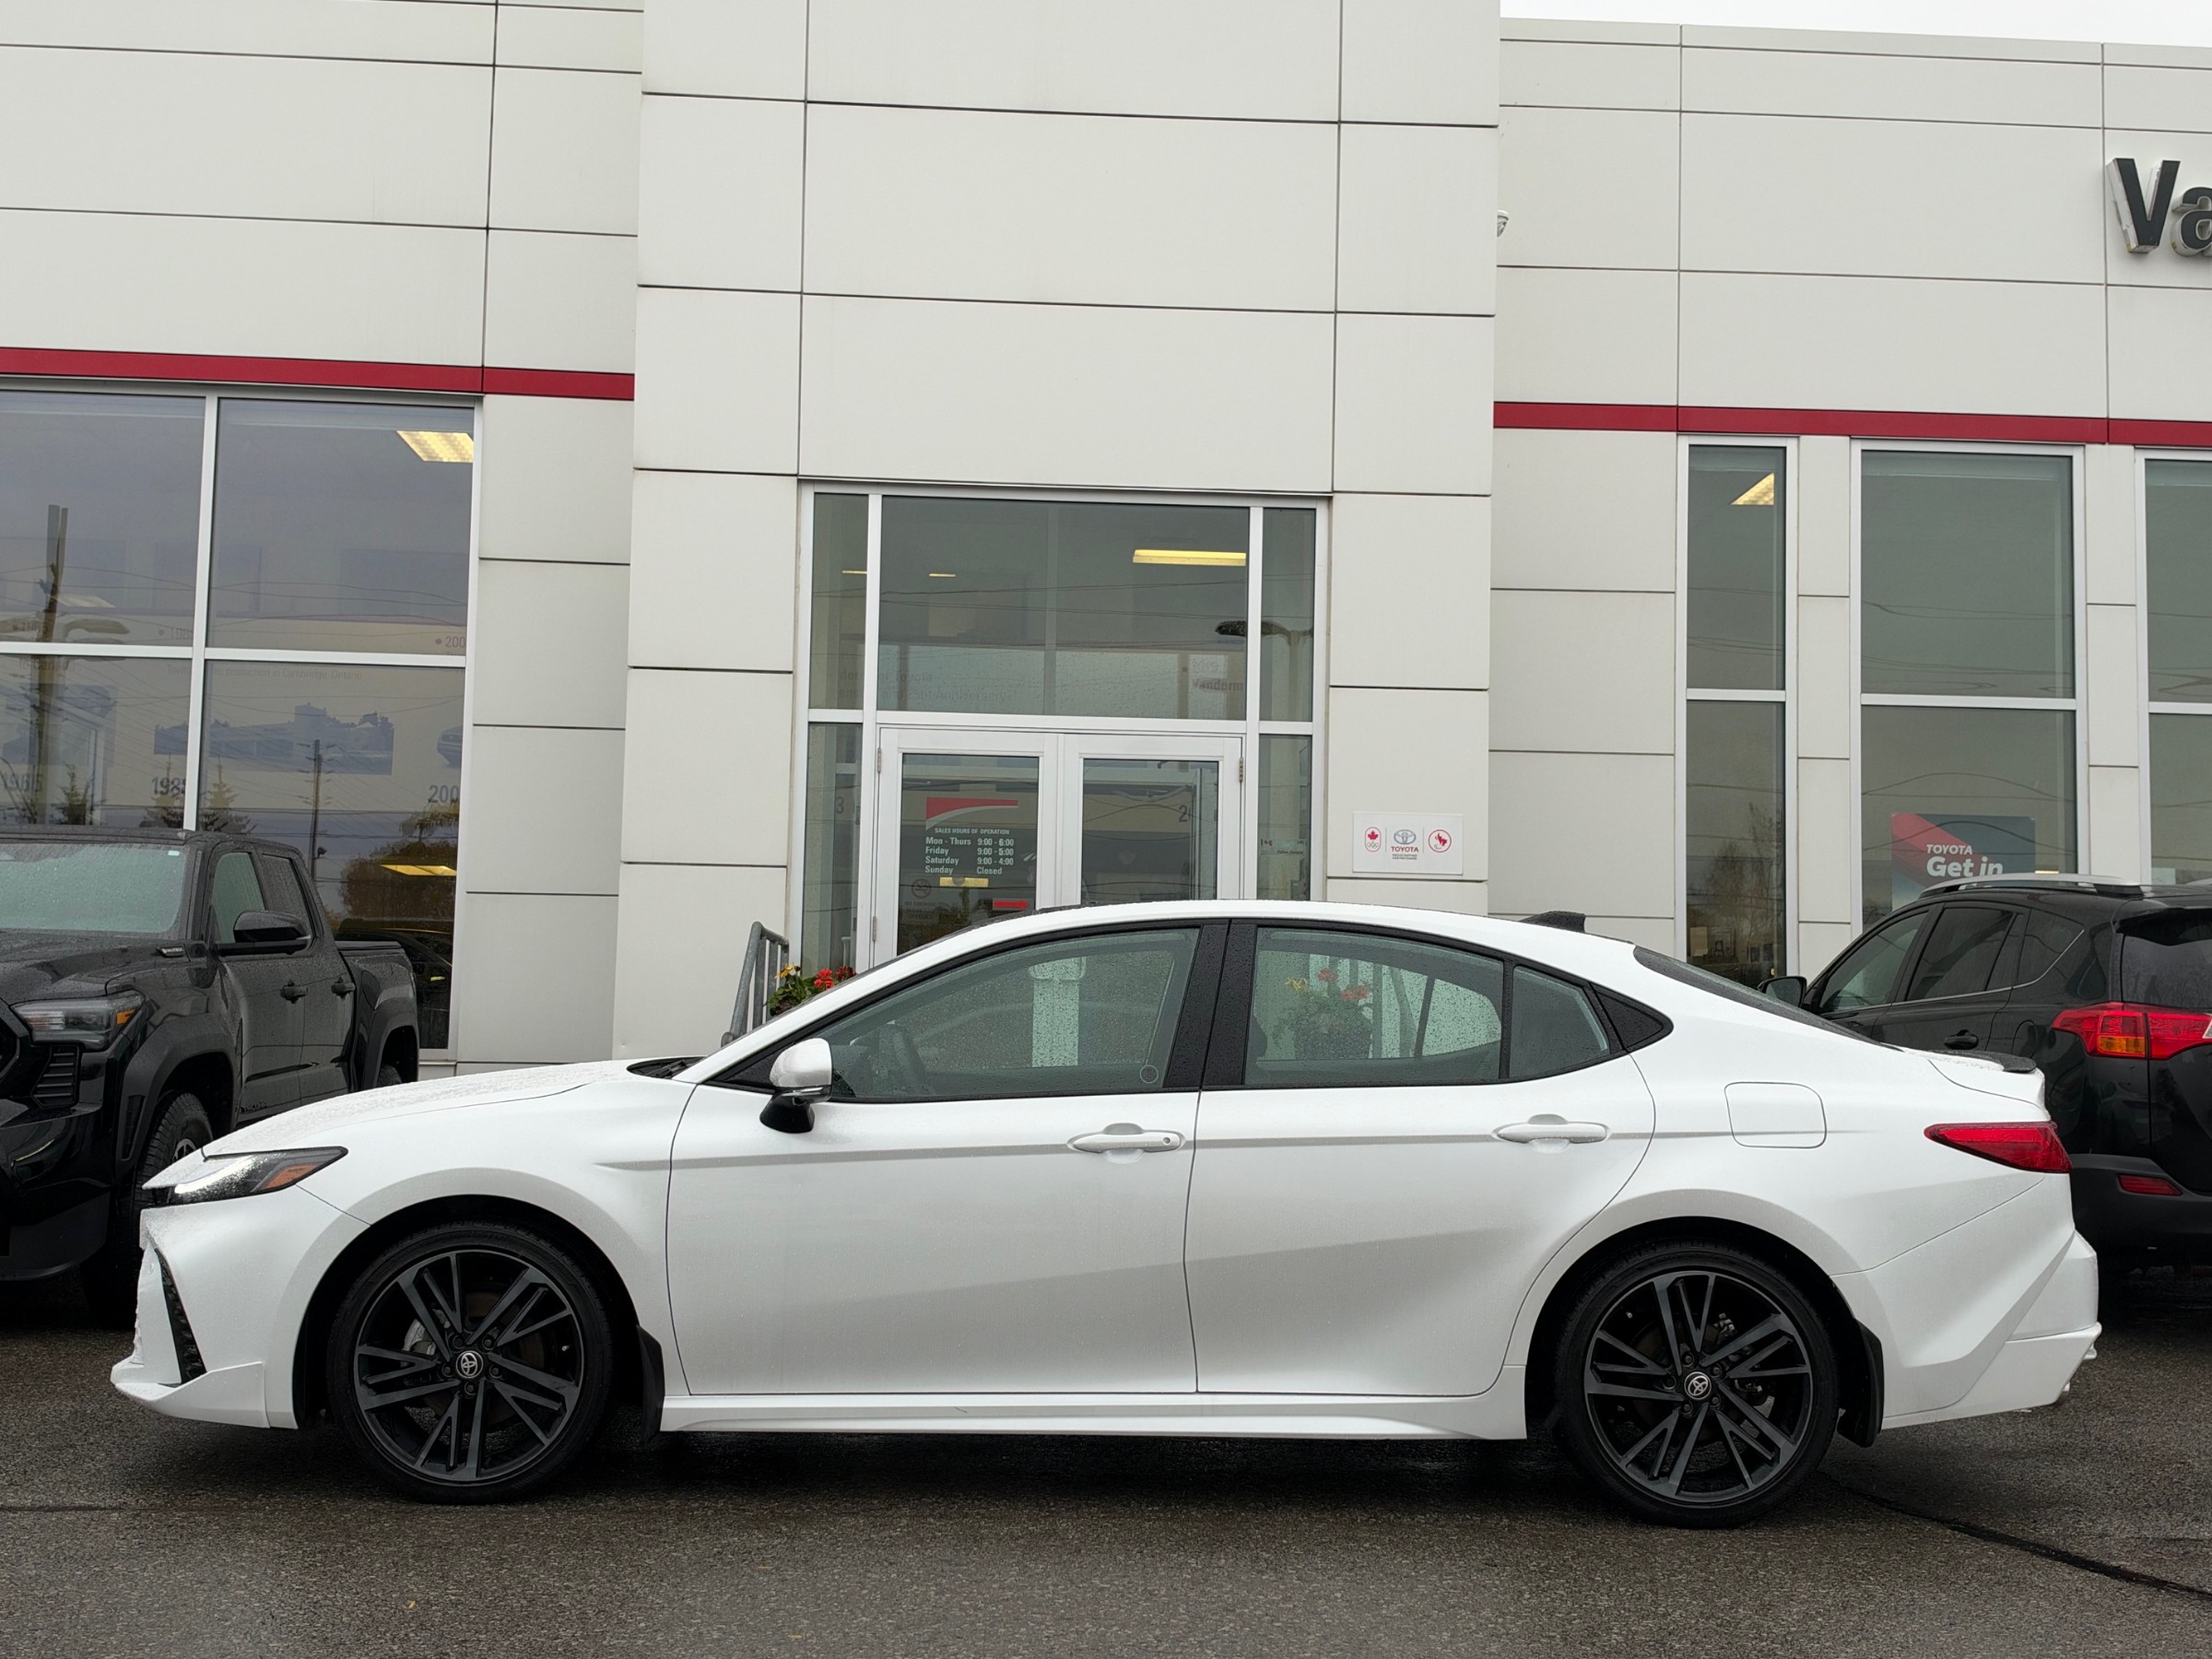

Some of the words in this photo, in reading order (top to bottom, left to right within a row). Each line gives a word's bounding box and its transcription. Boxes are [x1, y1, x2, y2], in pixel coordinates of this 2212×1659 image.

[925, 836, 944, 845] Mon
[949, 837, 971, 845] Thurs
[977, 838, 993, 846] 9:00
[925, 846, 949, 856] Friday
[977, 847, 993, 855] 9:00
[1391, 845, 1419, 853] TOYOTA
[1926, 843, 1973, 855] TOYOTA
[924, 856, 959, 866] Saturday
[977, 857, 993, 865] 9:00
[998, 857, 1014, 865] 4:00
[924, 865, 954, 875] Sunday
[976, 866, 1003, 875] Closed
[1926, 856, 1974, 877] Get
[1979, 856, 2004, 877] in
